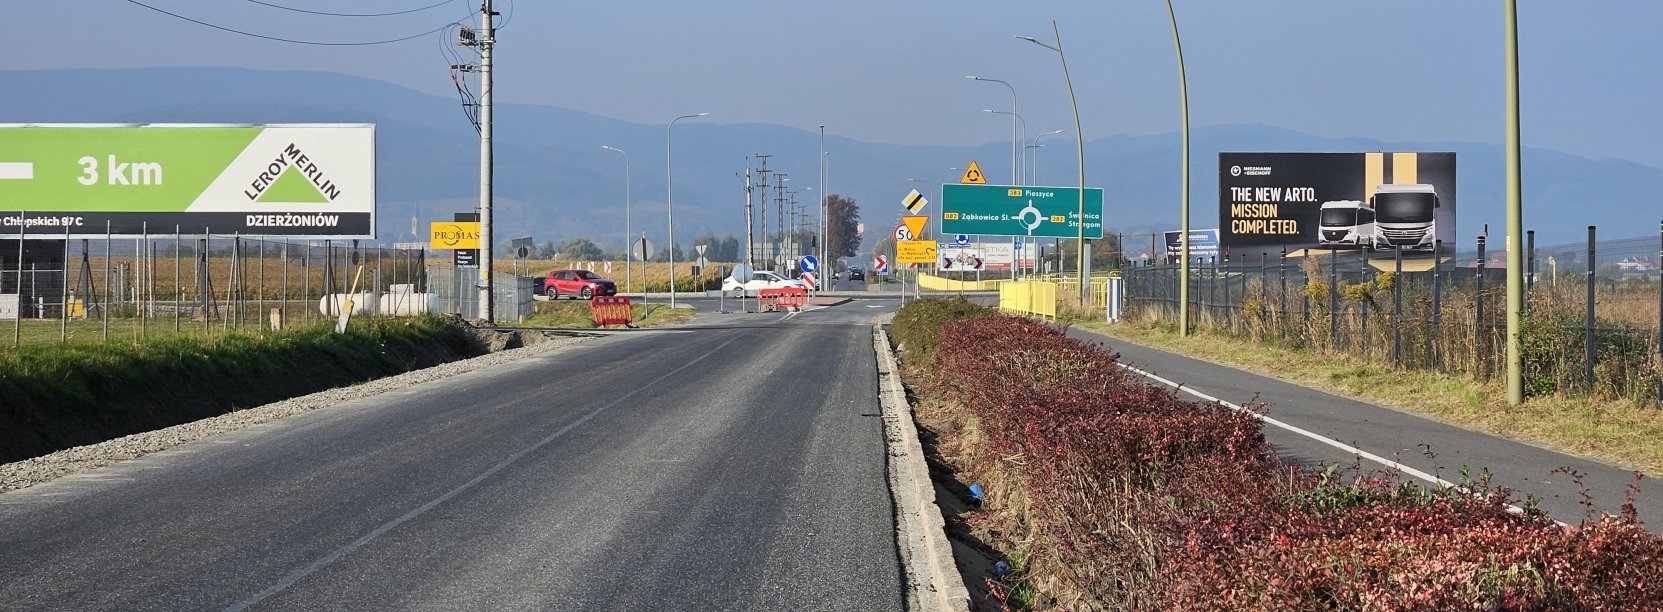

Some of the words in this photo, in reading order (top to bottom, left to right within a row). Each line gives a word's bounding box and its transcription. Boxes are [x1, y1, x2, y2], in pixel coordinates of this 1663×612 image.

[77, 156, 99, 186] 3
[108, 154, 163, 186] km
[245, 153, 288, 200] LEROY
[284, 142, 340, 200] MERLIN
[1025, 190, 1054, 199] Pieszyce
[1231, 187, 1252, 201] THE
[1255, 187, 1281, 201] NEW
[1285, 187, 1317, 202] ARTO.
[961, 213, 999, 221] Ząbkowice
[1231, 204, 1278, 218] MISSION
[75, 216, 83, 226] C
[246, 212, 339, 227] DZIERŻONIÓW
[1068, 220, 1101, 230] Stregom
[1231, 220, 1299, 234] COMPLETED.
[898, 229, 913, 241] 50
